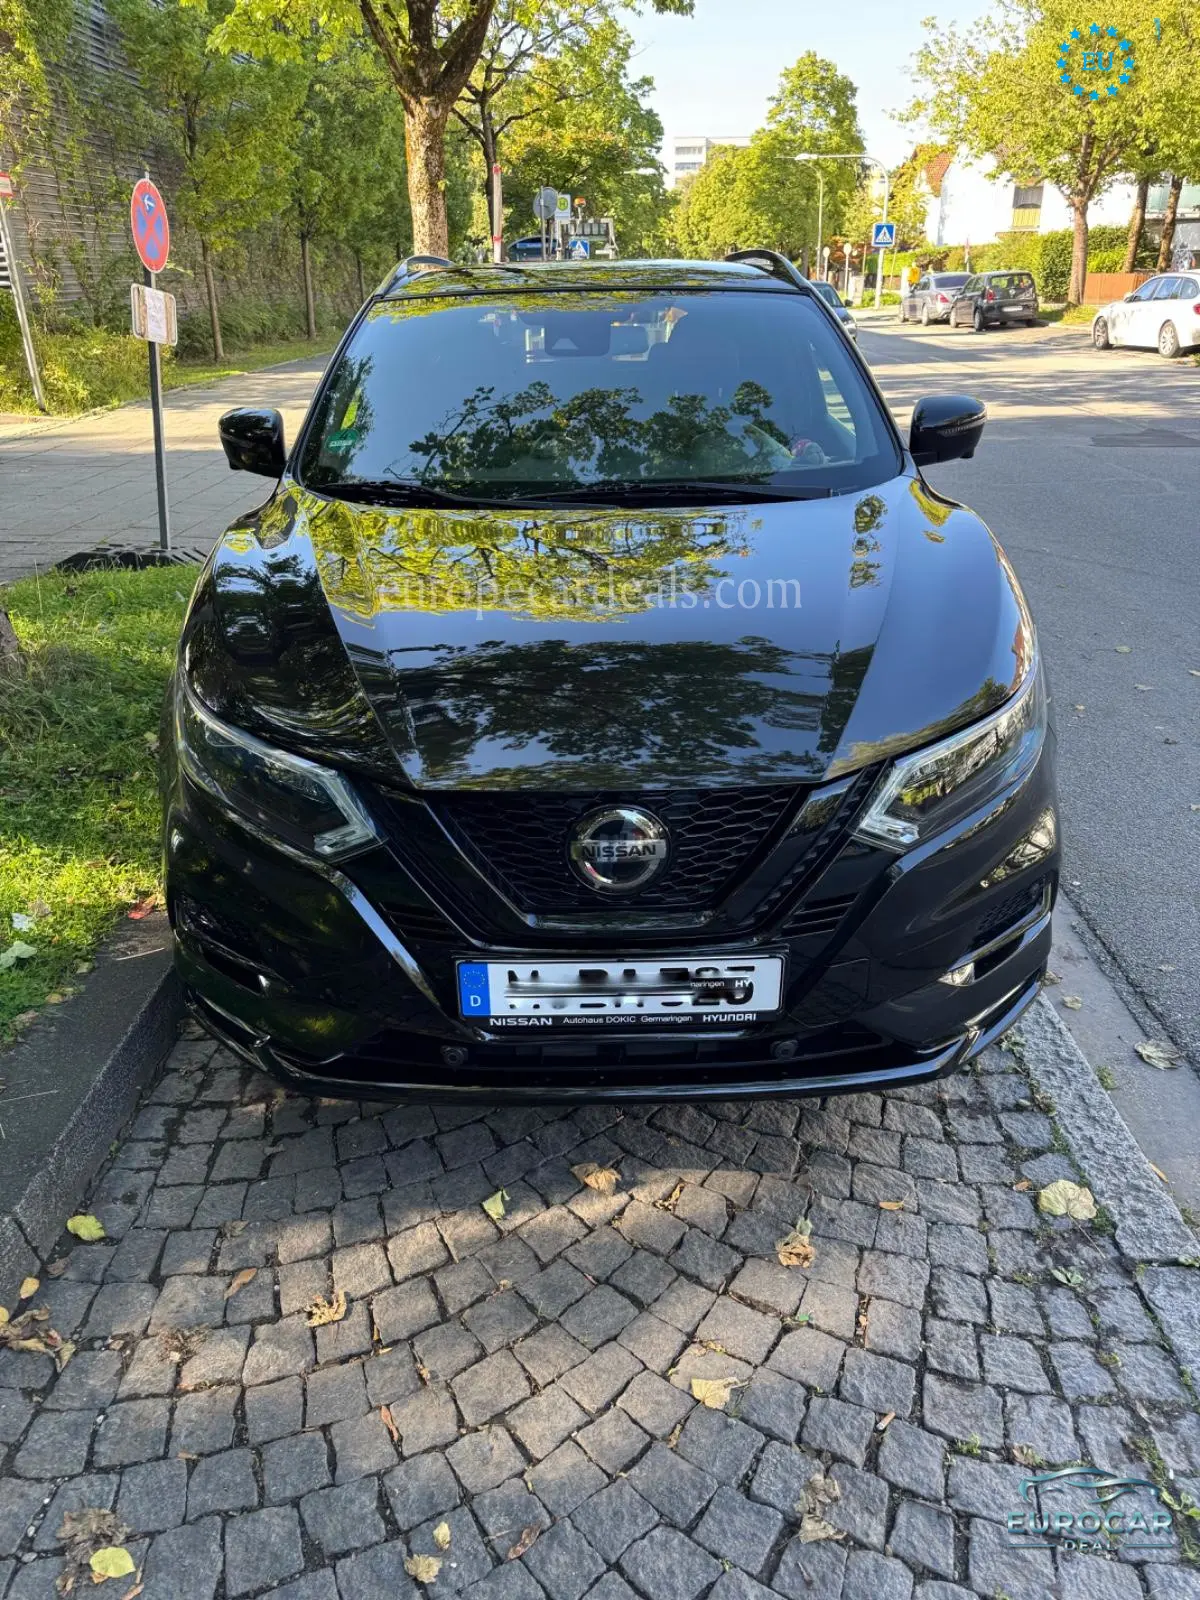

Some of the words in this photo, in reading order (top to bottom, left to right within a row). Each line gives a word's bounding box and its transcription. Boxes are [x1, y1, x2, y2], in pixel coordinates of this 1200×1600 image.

[582, 844, 656, 857] NISSAN
[470, 995, 481, 1007] D
[490, 1017, 553, 1026] NISSAN
[563, 1016, 604, 1024] Autohaus
[640, 1015, 693, 1024] Germaringen
[702, 1013, 757, 1022] HYUNDAI
